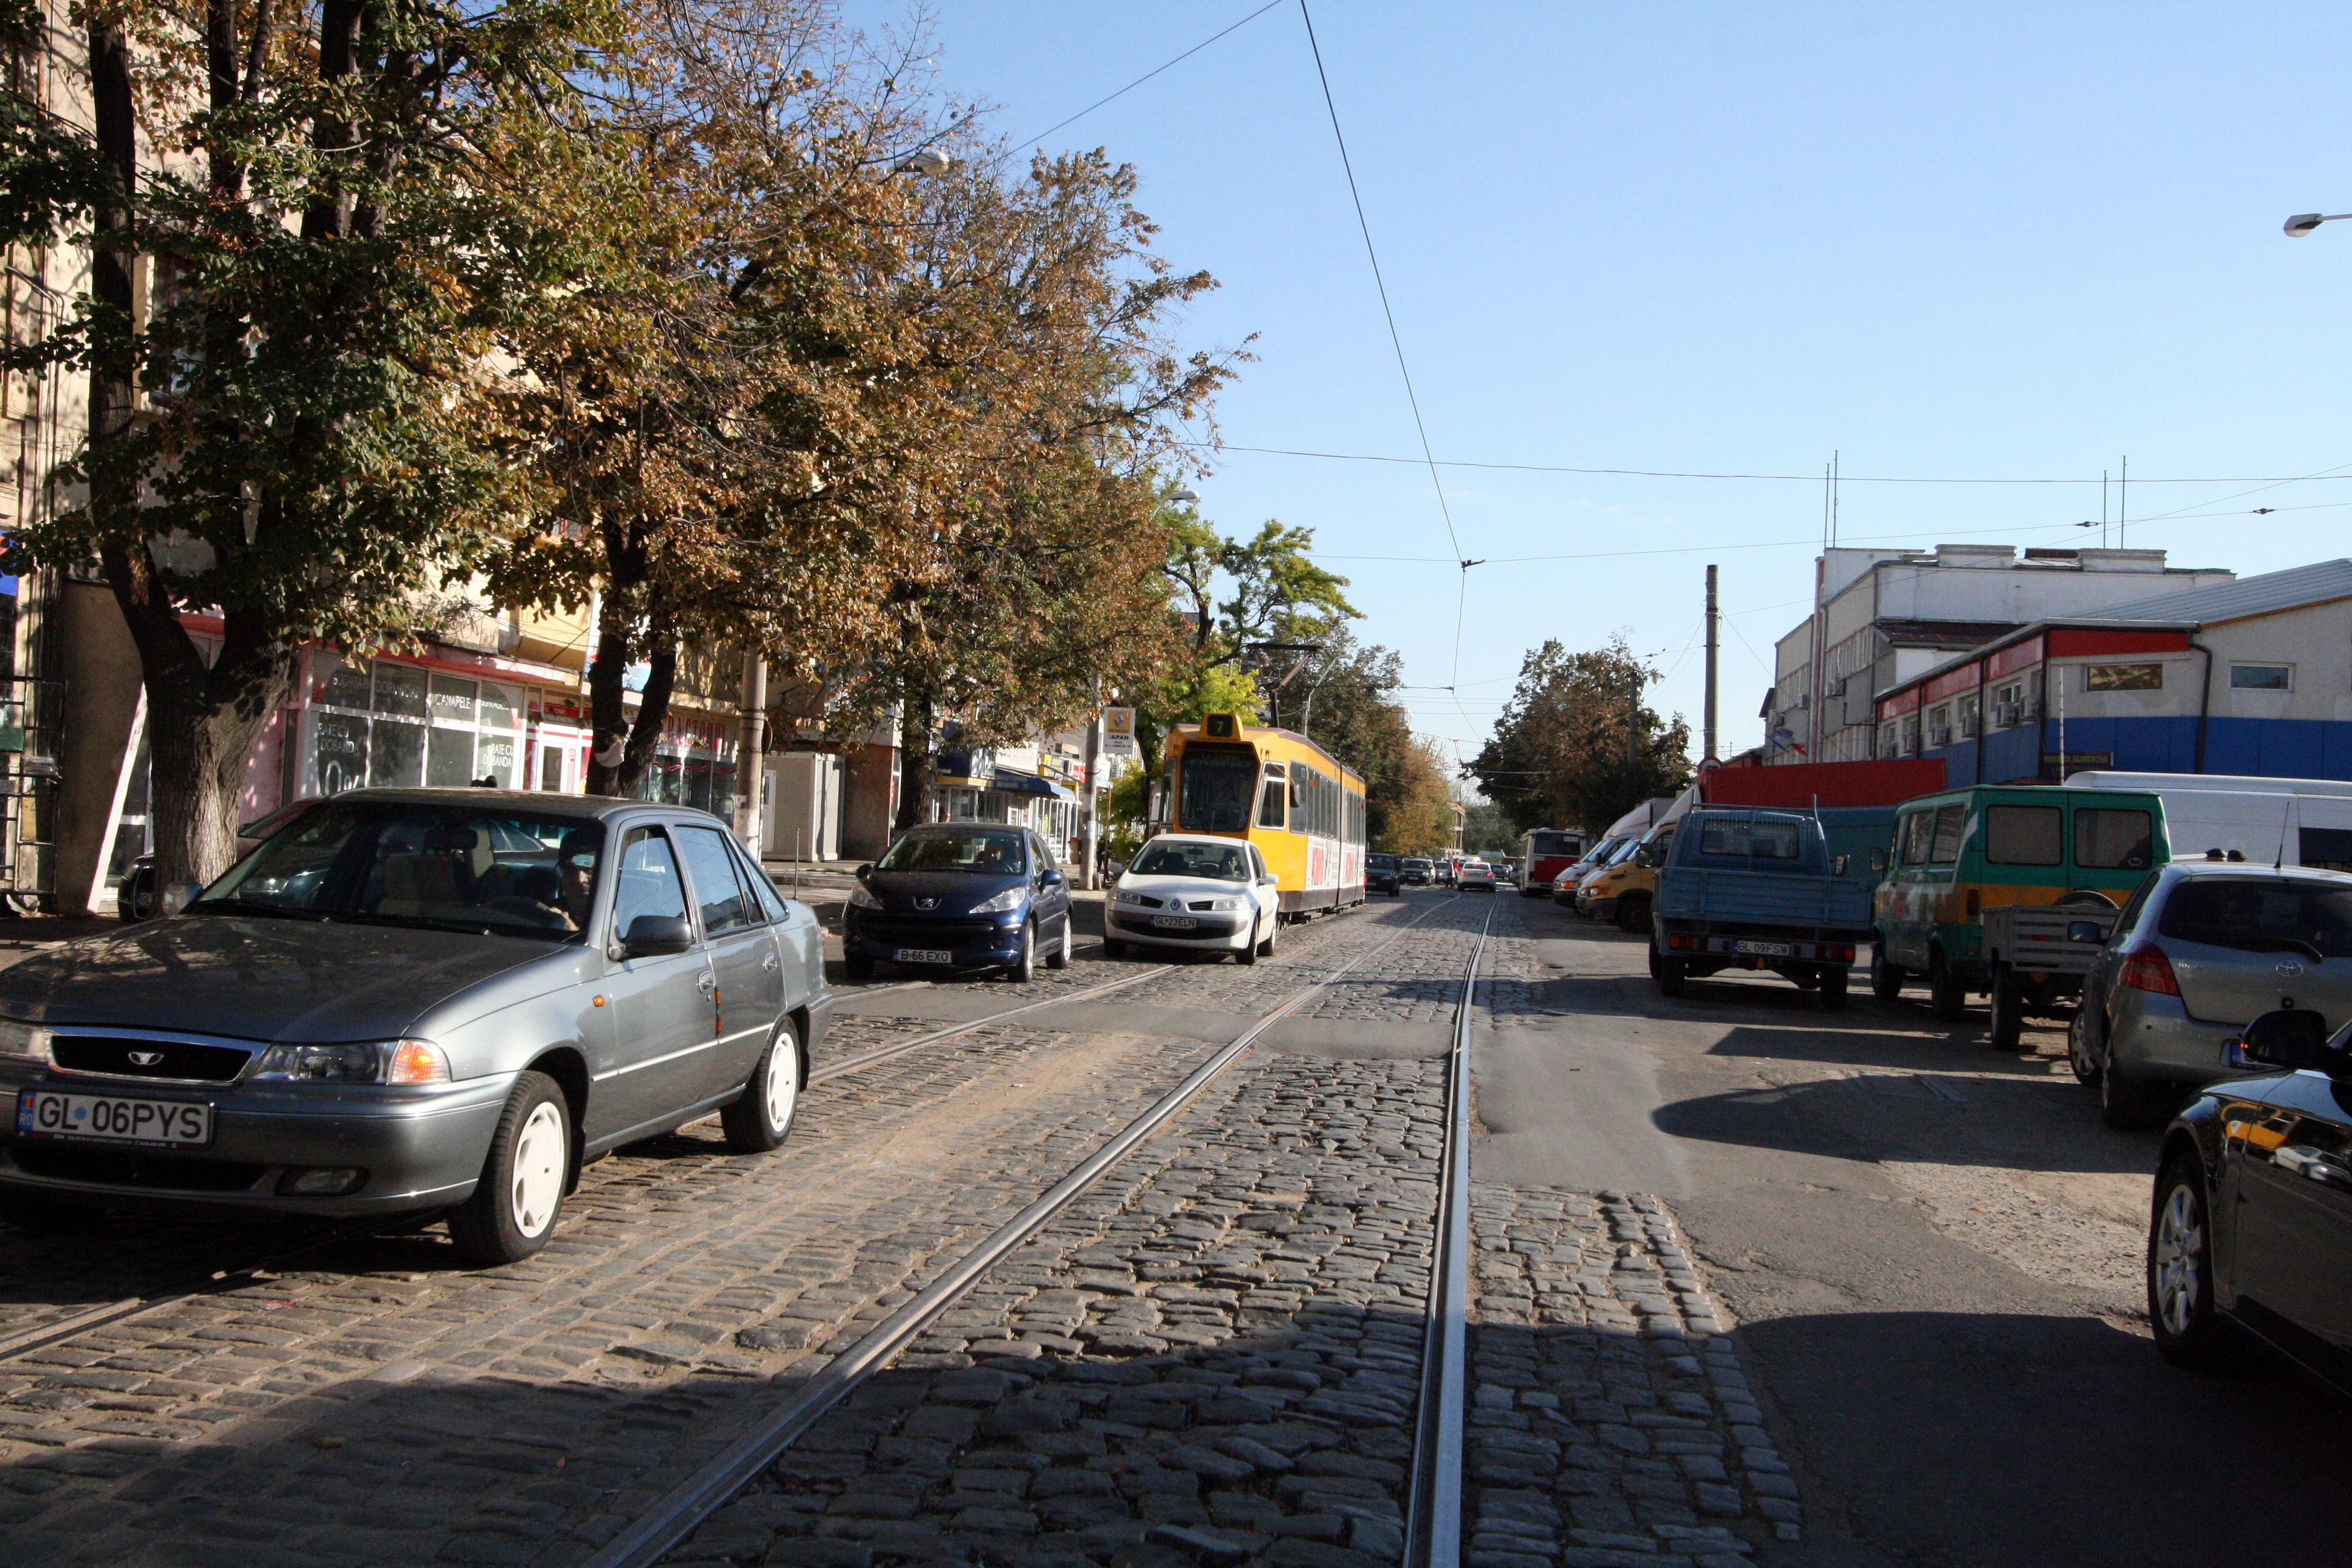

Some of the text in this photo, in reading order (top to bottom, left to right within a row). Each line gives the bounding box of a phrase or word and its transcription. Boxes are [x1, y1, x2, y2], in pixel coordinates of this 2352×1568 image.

[436, 694, 471, 710] CANAPELE
[318, 723, 349, 738] RATE CU
[1217, 720, 1224, 733] 7
[320, 739, 359, 756] DOBANDA
[491, 743, 514, 756] RATE CU
[483, 754, 512, 768] DOBANDA
[1155, 916, 1195, 927] GL 23ELN
[1738, 942, 1750, 952] GL
[912, 951, 924, 961] 66
[927, 952, 948, 962] EXO
[38, 1096, 201, 1139] GL 06PYS
